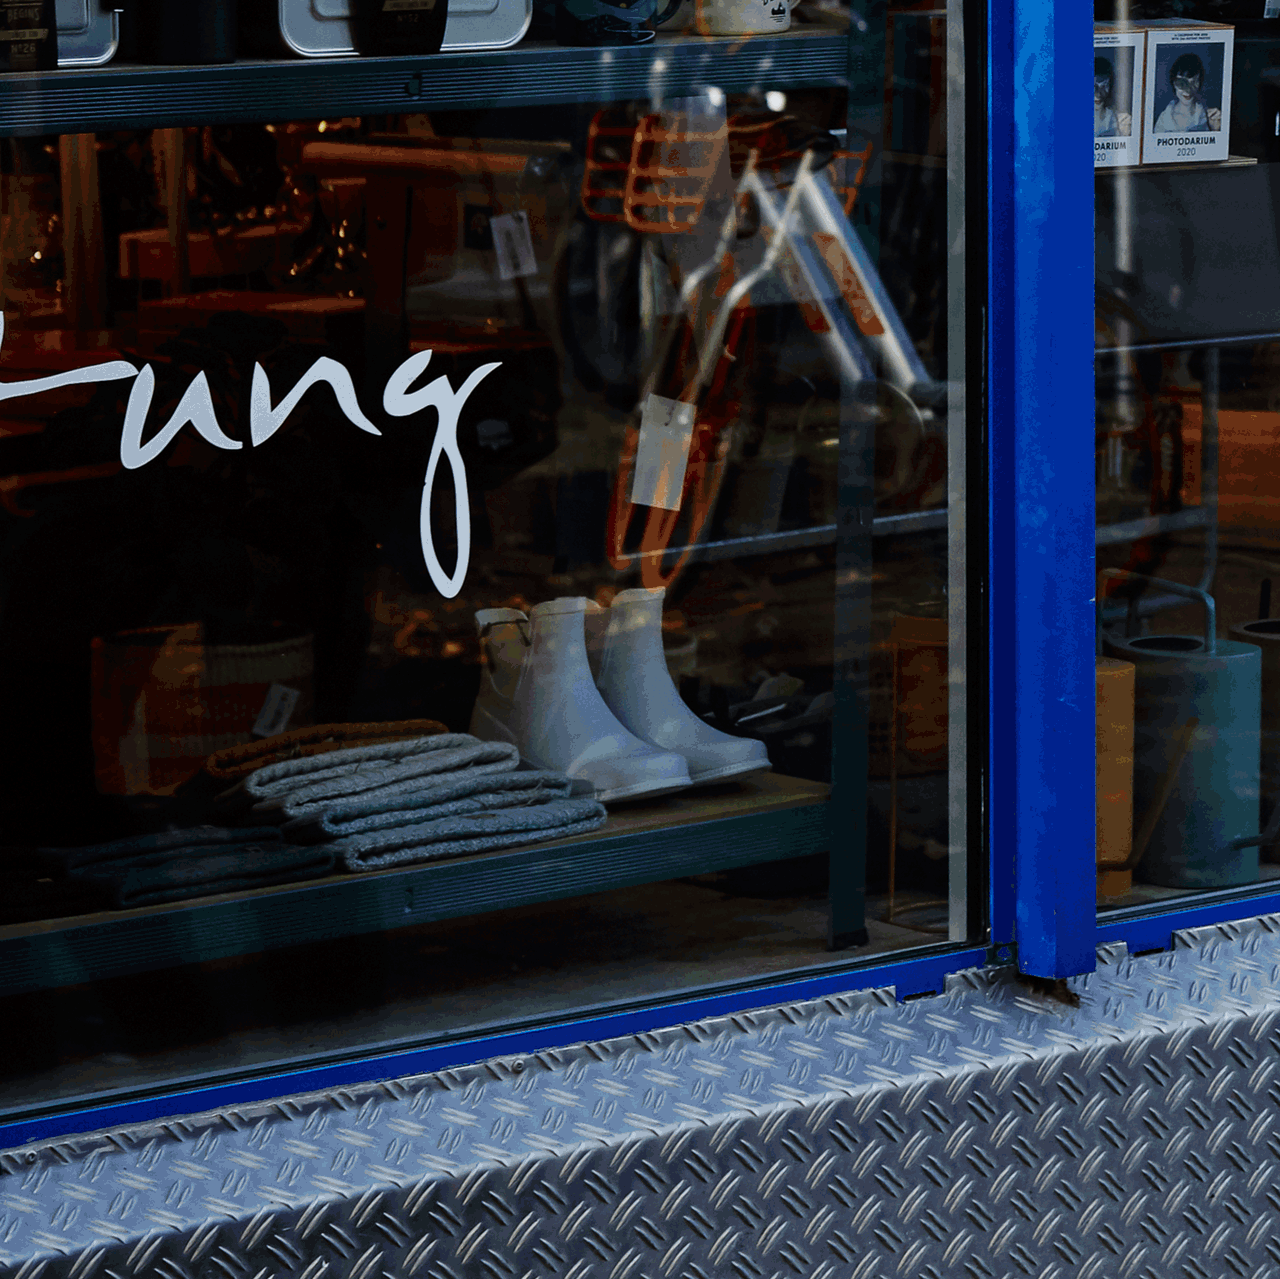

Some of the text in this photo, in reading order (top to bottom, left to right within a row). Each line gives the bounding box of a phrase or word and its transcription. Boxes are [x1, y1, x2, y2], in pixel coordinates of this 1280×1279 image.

[1156, 136, 1216, 147] PHOTODARIUM
[1176, 147, 1196, 157] 2020
[0, 310, 503, 599] ung
